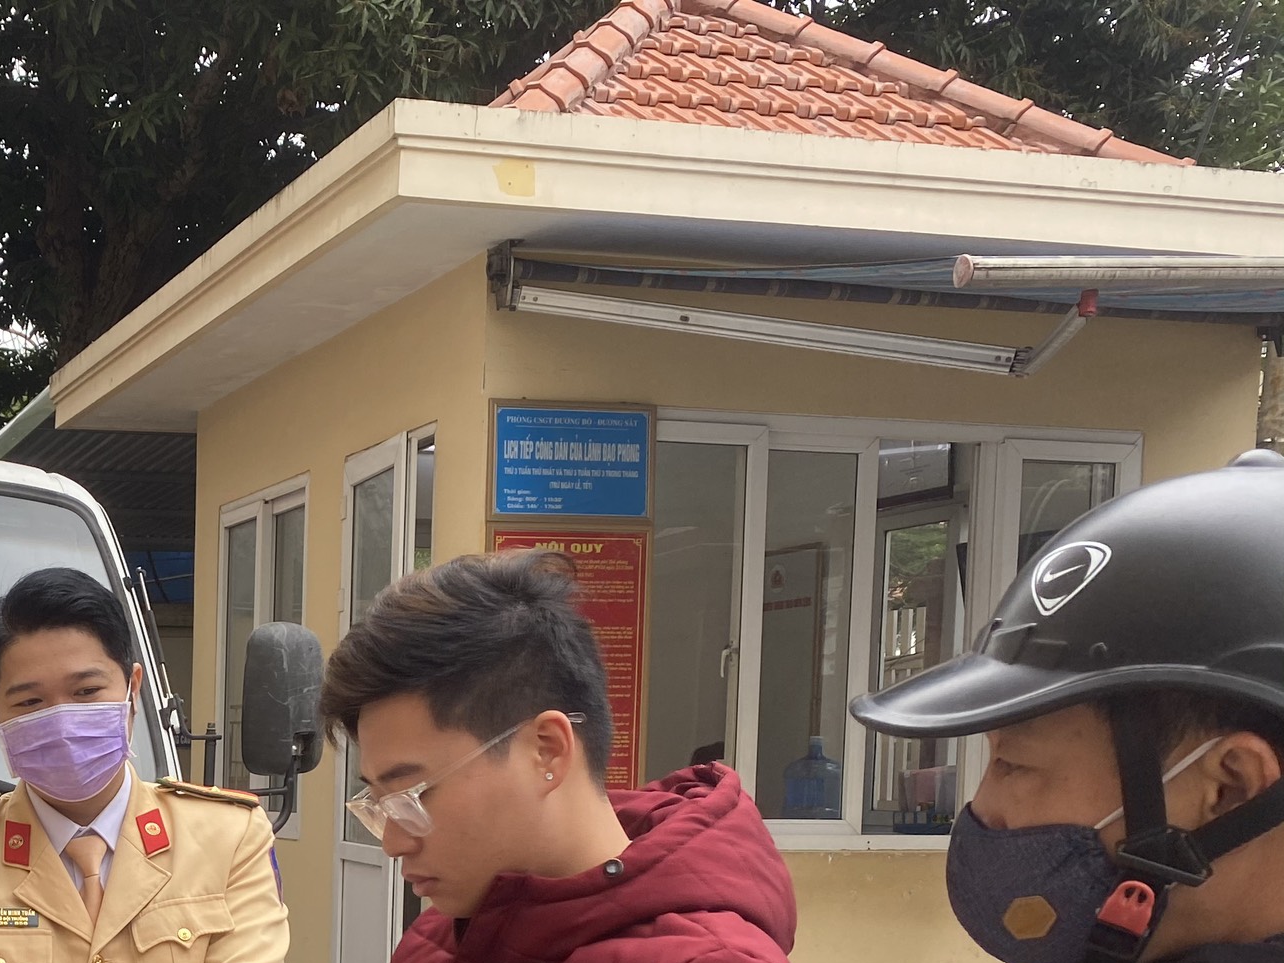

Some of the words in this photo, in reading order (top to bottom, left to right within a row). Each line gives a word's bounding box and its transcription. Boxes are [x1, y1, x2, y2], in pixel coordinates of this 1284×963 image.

[504, 439, 518, 463] LỊCH
[520, 433, 534, 460] TIẾP
[535, 437, 553, 460] CÔNG
[554, 438, 568, 461] DÂN
[569, 433, 583, 461] CỦA
[571, 543, 604, 553] QUY
